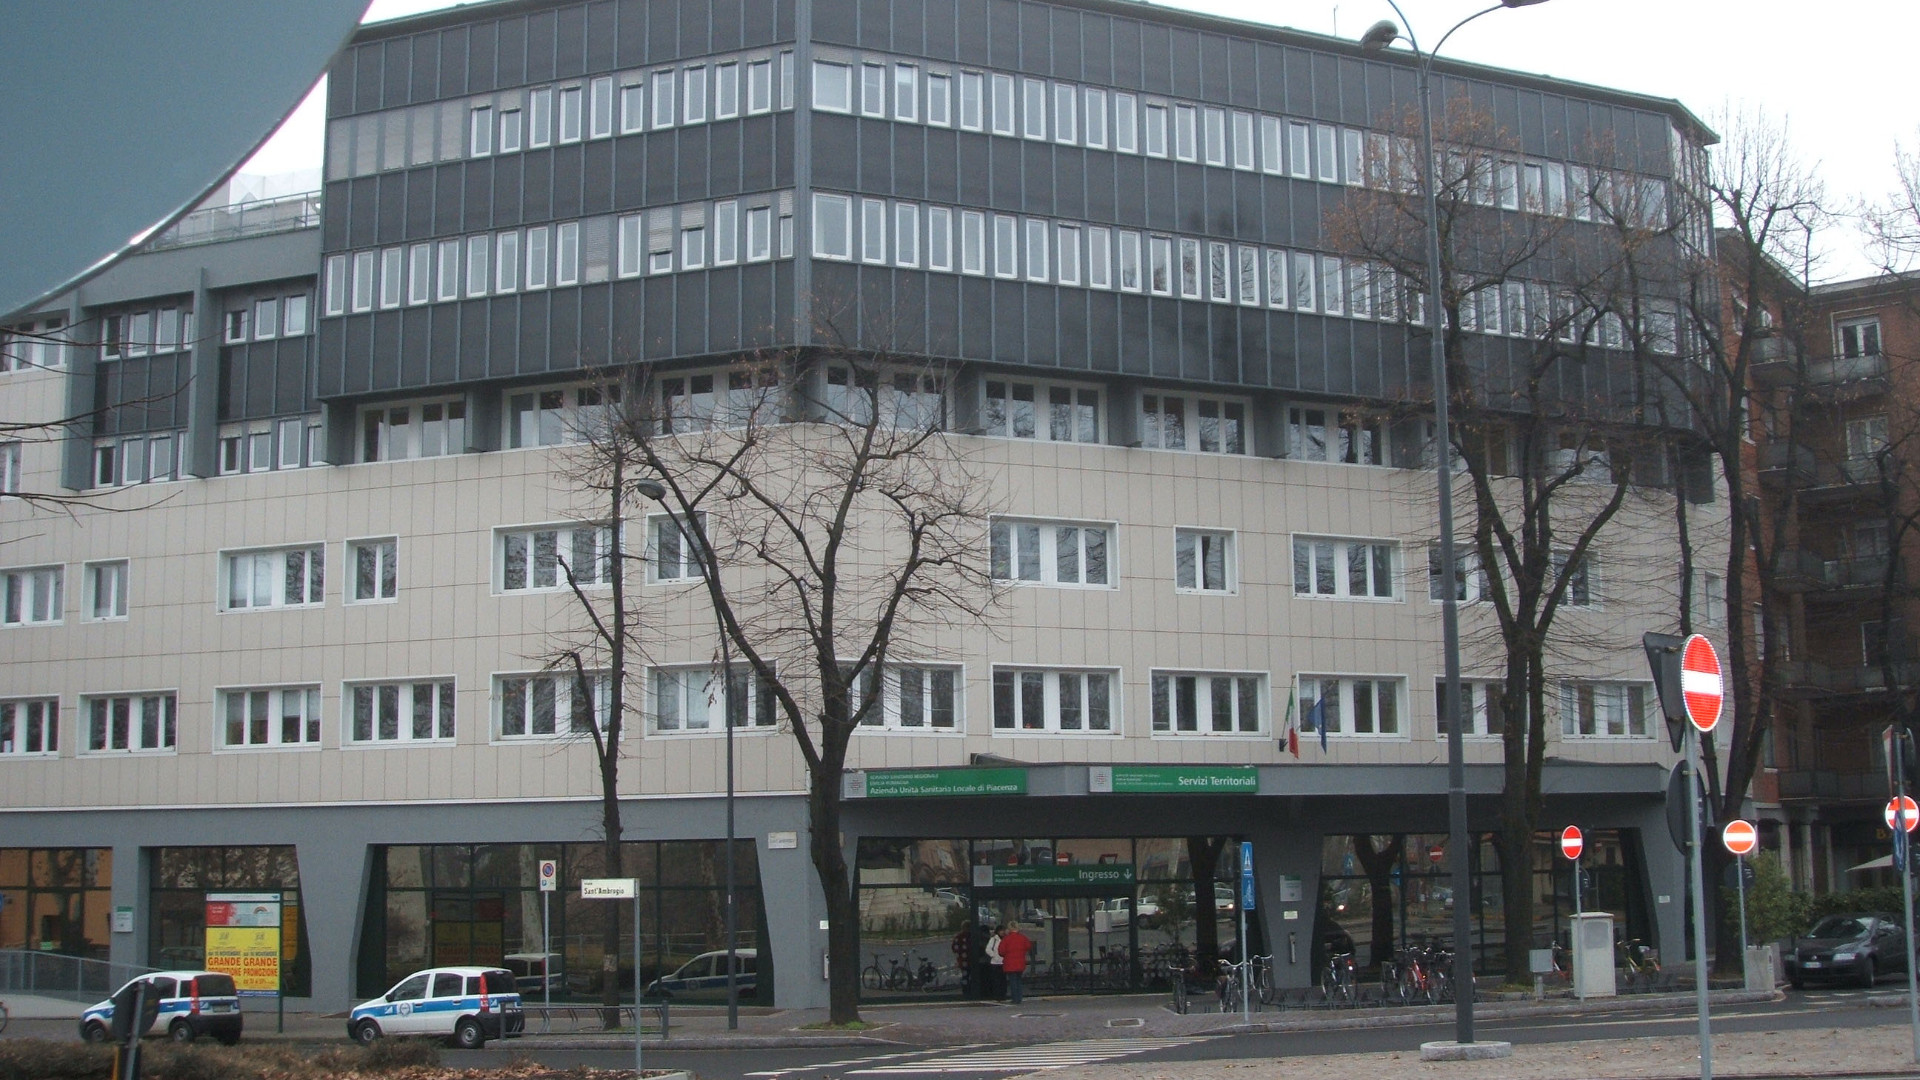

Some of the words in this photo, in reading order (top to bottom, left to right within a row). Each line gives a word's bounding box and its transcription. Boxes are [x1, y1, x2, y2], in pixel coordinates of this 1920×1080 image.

[1178, 776, 1208, 786] Servizi
[1210, 776, 1256, 786] Territoriali
[870, 786, 898, 794] Azienda
[920, 785, 951, 793] Sanitaria
[953, 784, 976, 792] Locale
[978, 784, 984, 792] di
[986, 783, 1018, 792] Piacenza
[1078, 870, 1120, 881] Ingresso
[584, 888, 624, 896] Sant'Ambrogio
[208, 957, 241, 966] GRANDE
[244, 958, 278, 966] GRANDE
[244, 968, 278, 976] PROMOZIONE
